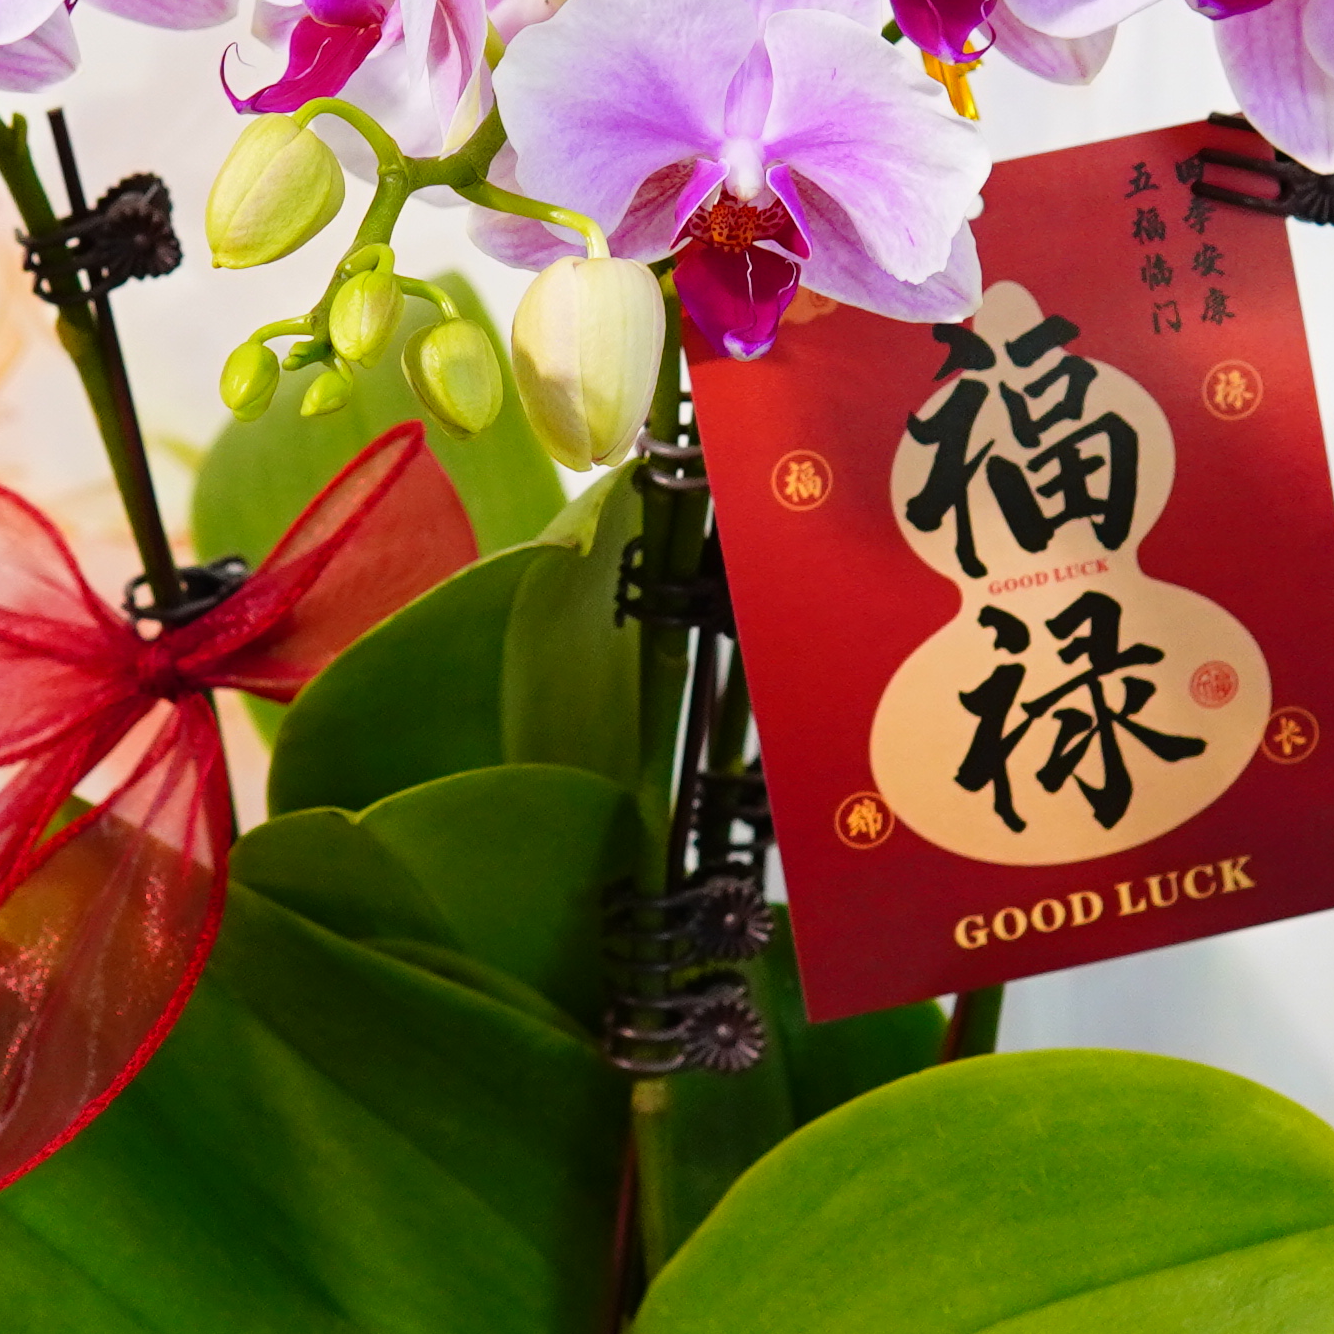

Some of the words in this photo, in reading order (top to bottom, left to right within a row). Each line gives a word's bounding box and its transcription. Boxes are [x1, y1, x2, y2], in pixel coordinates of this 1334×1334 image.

[1125, 161, 1183, 335] 五福临门
[1214, 369, 1254, 410] 禄
[784, 460, 823, 503] 福
[905, 315, 1139, 579] 福
[988, 572, 1049, 595] GOOD
[1053, 558, 1109, 583] LUCK
[954, 591, 1206, 833] 禄
[1273, 716, 1307, 757] 长
[953, 889, 1105, 951] GOOD
[1114, 855, 1256, 917] LUCK
